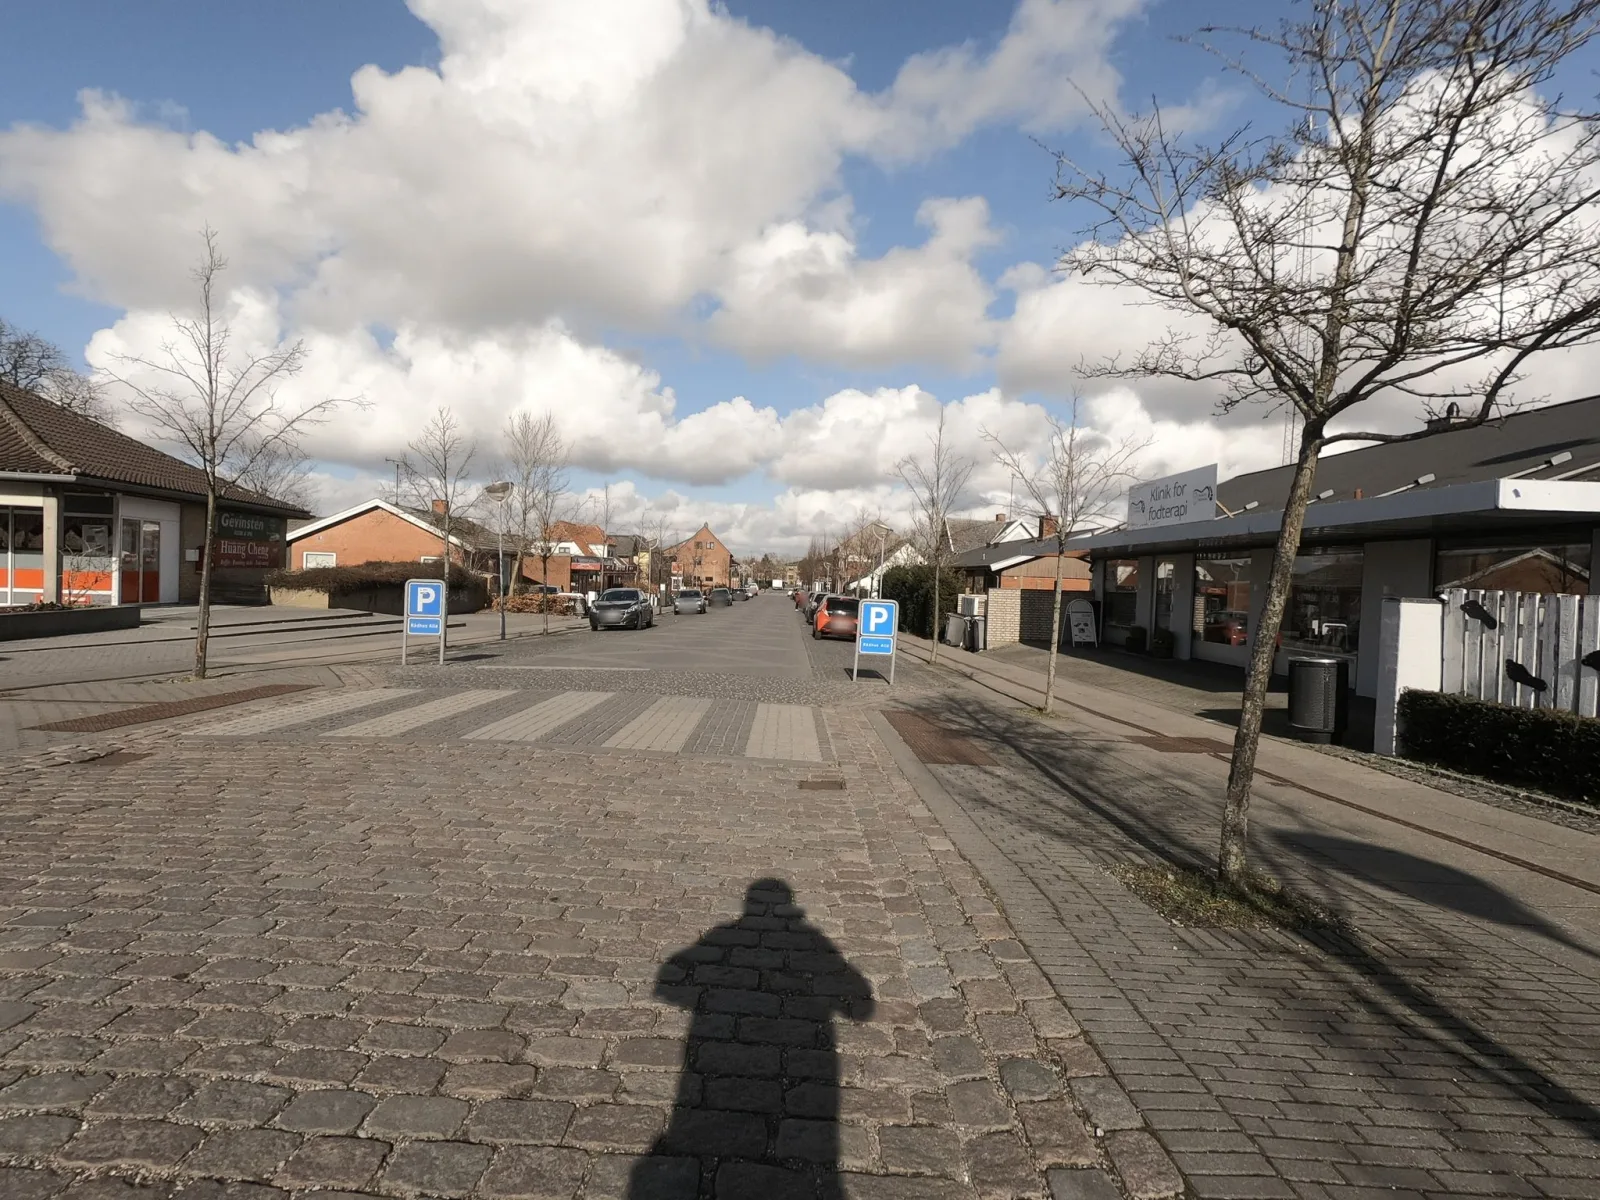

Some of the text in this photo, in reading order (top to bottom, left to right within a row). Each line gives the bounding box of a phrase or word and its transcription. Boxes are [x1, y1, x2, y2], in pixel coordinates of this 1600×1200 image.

[1150, 484, 1171, 502] Klinik
[1173, 481, 1187, 497] for
[1148, 500, 1188, 521] fodterapi
[221, 513, 264, 530] Gevinsten
[220, 540, 269, 559] Huang Cheng
[417, 587, 436, 612] P
[869, 607, 888, 632] P
